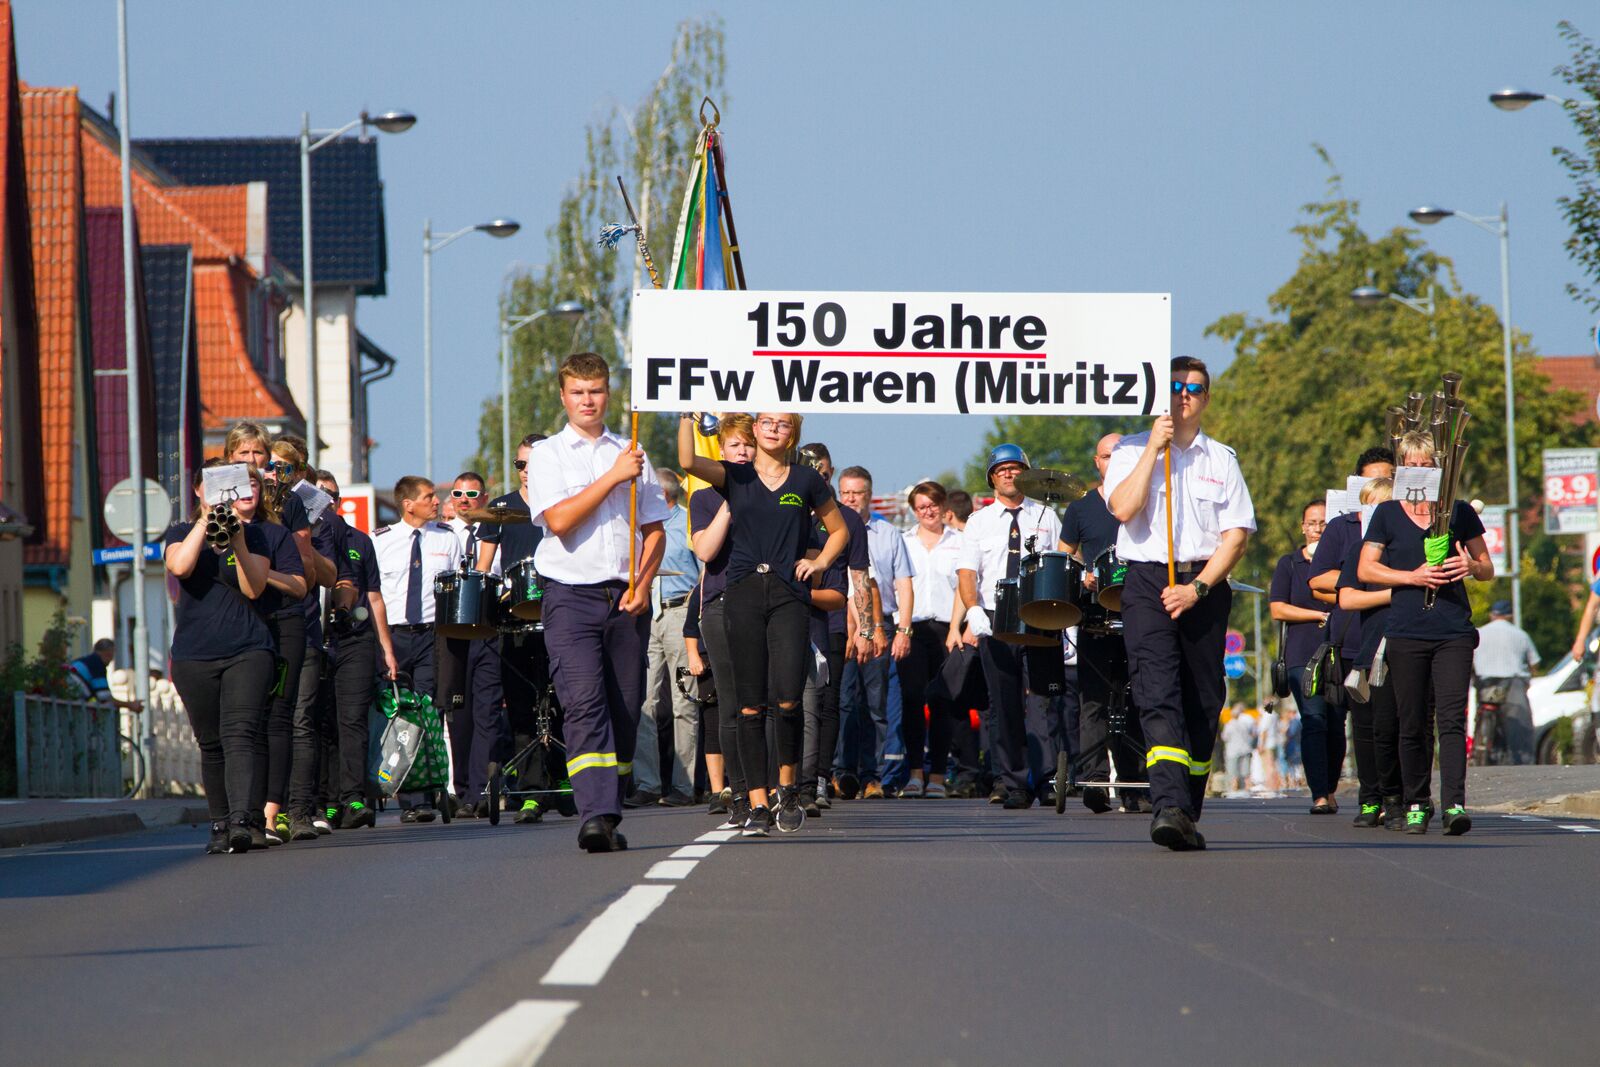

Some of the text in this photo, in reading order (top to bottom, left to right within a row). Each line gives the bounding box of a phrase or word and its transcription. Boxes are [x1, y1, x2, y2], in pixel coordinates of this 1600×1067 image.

[748, 301, 1048, 351] 150 Jahre
[647, 357, 1156, 415] FFw Waren (Müritz)
[1547, 475, 1598, 500] 8.9.
